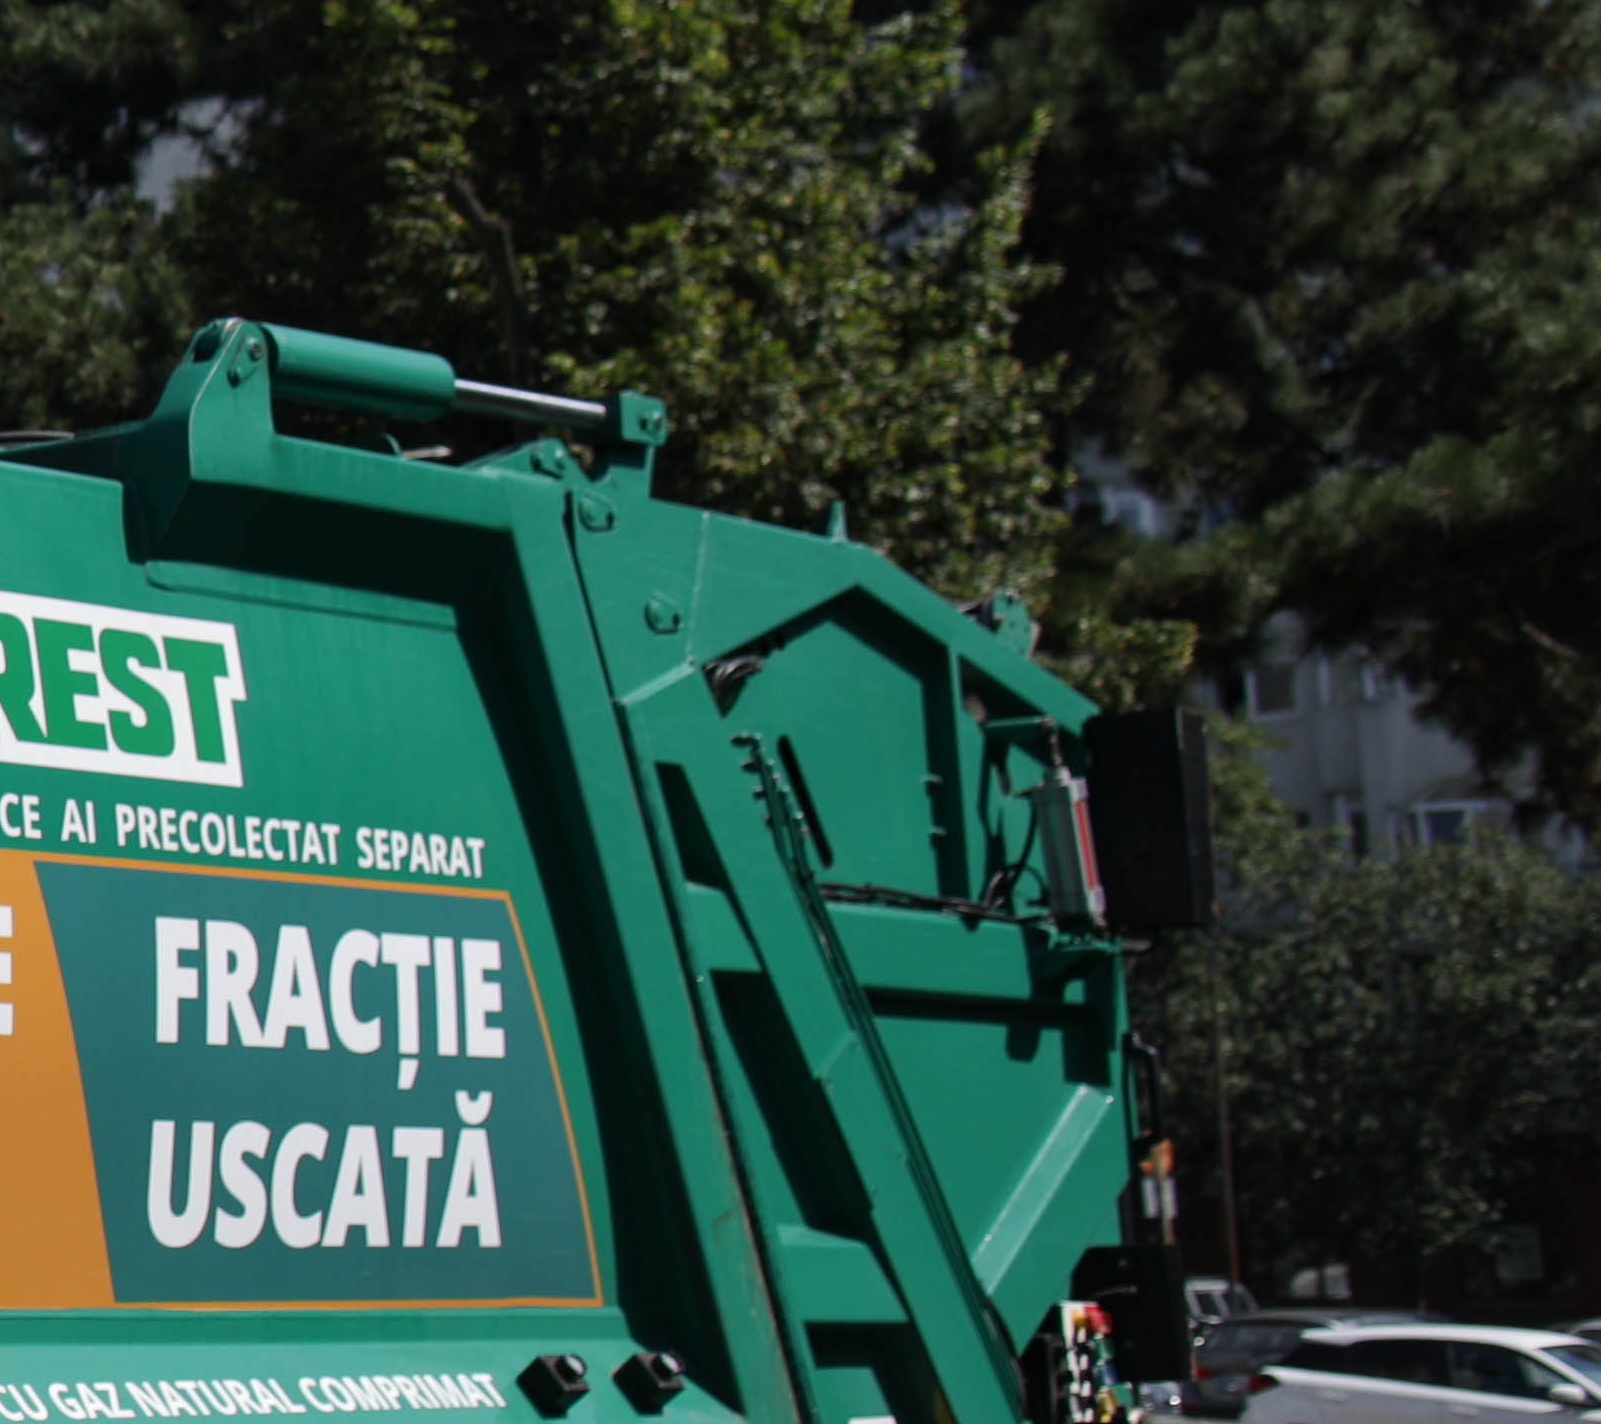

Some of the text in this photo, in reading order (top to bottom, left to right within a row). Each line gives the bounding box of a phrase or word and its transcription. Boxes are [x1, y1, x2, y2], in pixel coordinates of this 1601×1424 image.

[60, 798, 97, 844] AI
[114, 803, 342, 866] PRECOLECTAT
[355, 827, 486, 879] SEPARAT
[154, 916, 507, 1091] FRACȚIE
[147, 1091, 502, 1248] USCATĂ
[52, 1380, 135, 1422] GAZ
[134, 1376, 307, 1419] NATURAL
[299, 1372, 507, 1415] COMPRIMAT
